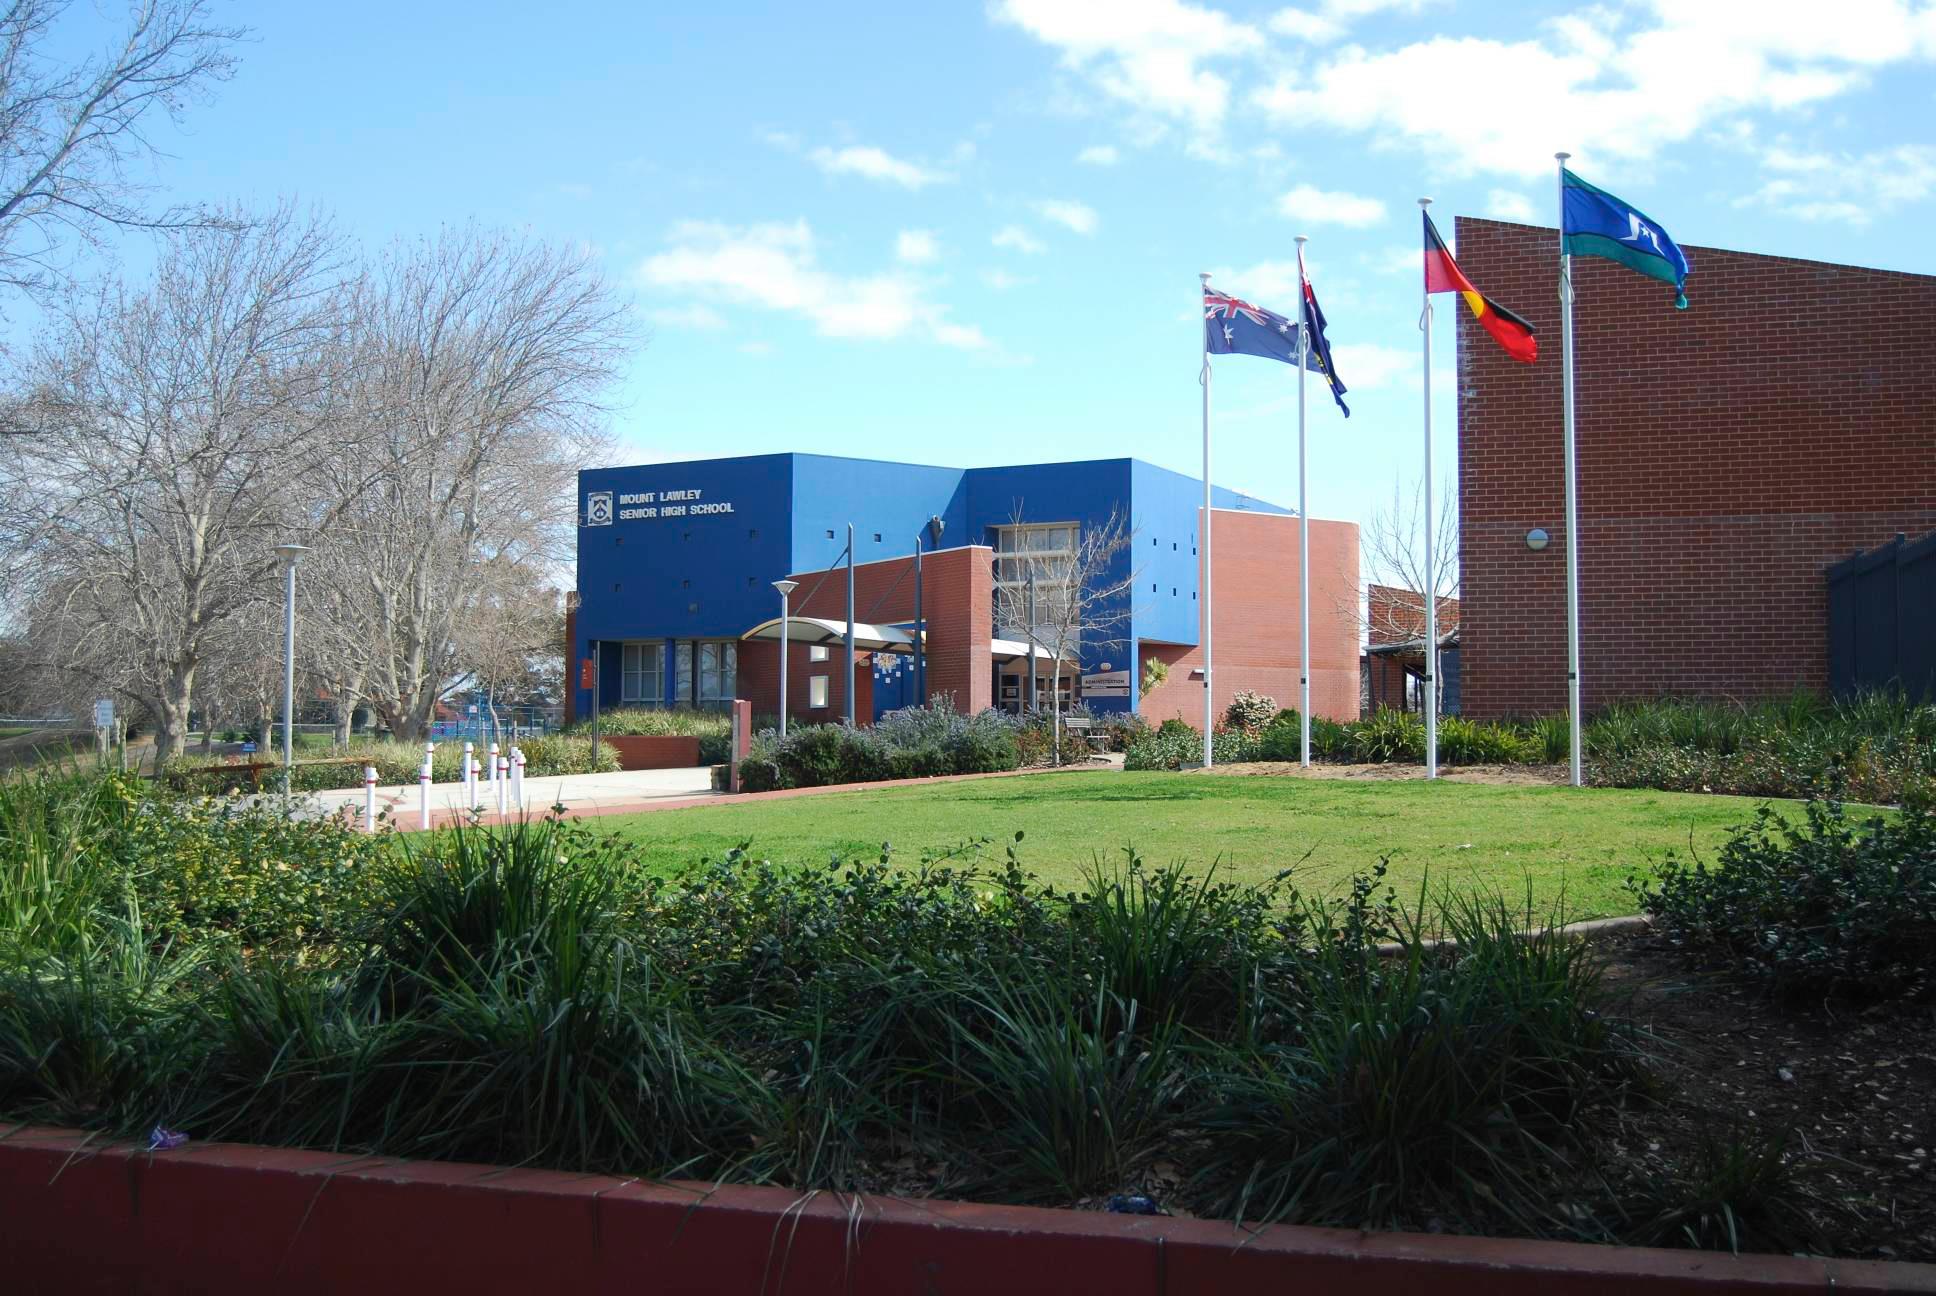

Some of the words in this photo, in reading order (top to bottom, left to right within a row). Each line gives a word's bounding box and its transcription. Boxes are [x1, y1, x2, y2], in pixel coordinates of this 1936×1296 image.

[619, 492, 656, 505] MOUNT
[660, 489, 702, 502] LAWLEY
[619, 507, 657, 520] SENIOR
[660, 505, 686, 517] HIGH
[689, 502, 735, 515] SCHOOL
